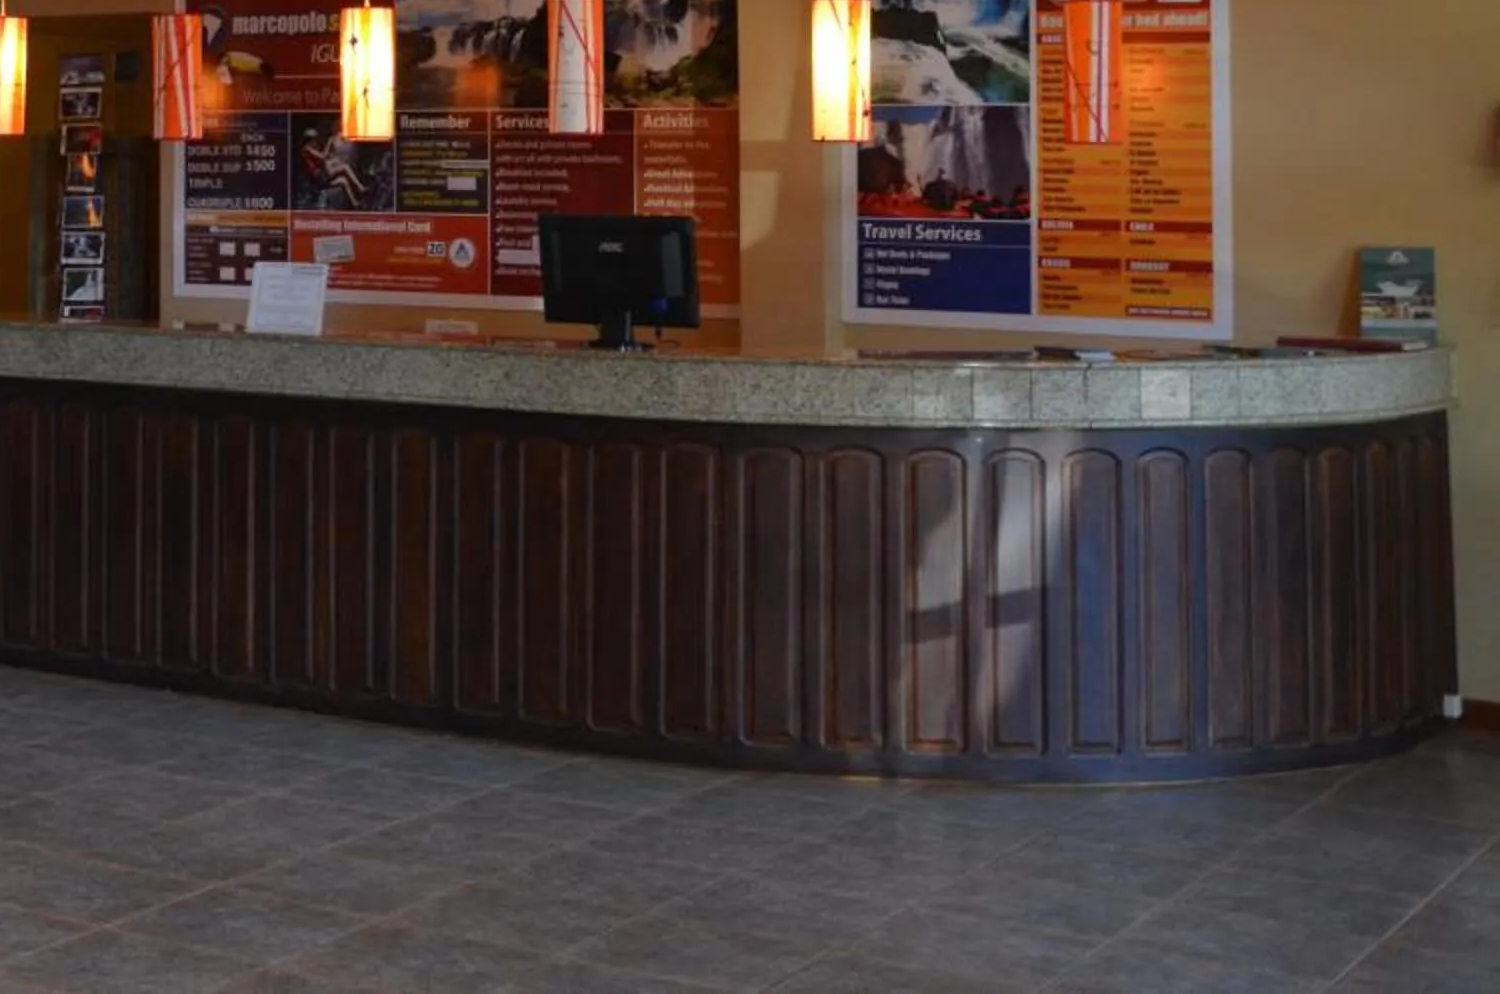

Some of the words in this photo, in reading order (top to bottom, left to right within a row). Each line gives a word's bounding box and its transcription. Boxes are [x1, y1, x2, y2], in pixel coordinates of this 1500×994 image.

[311, 43, 341, 64] IGU
[401, 114, 471, 129] Remember
[643, 113, 709, 128] Activities
[862, 223, 912, 240] Travel
[915, 224, 982, 242] Services
